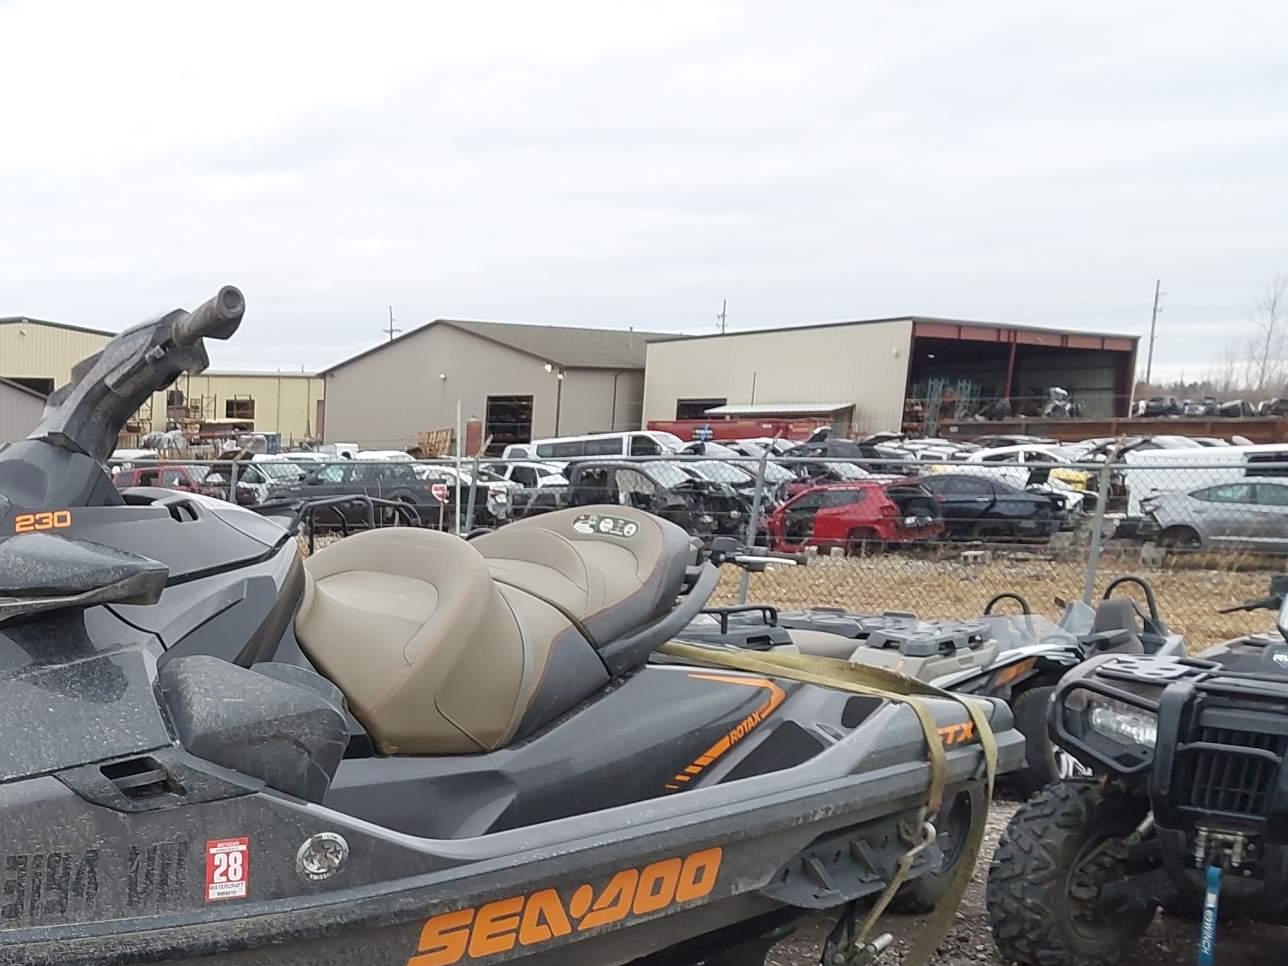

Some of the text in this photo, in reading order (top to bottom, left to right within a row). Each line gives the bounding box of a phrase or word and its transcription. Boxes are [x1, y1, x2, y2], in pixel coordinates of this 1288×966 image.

[15, 510, 71, 532] 230
[729, 710, 762, 745] ROTAX
[213, 851, 243, 883] 28
